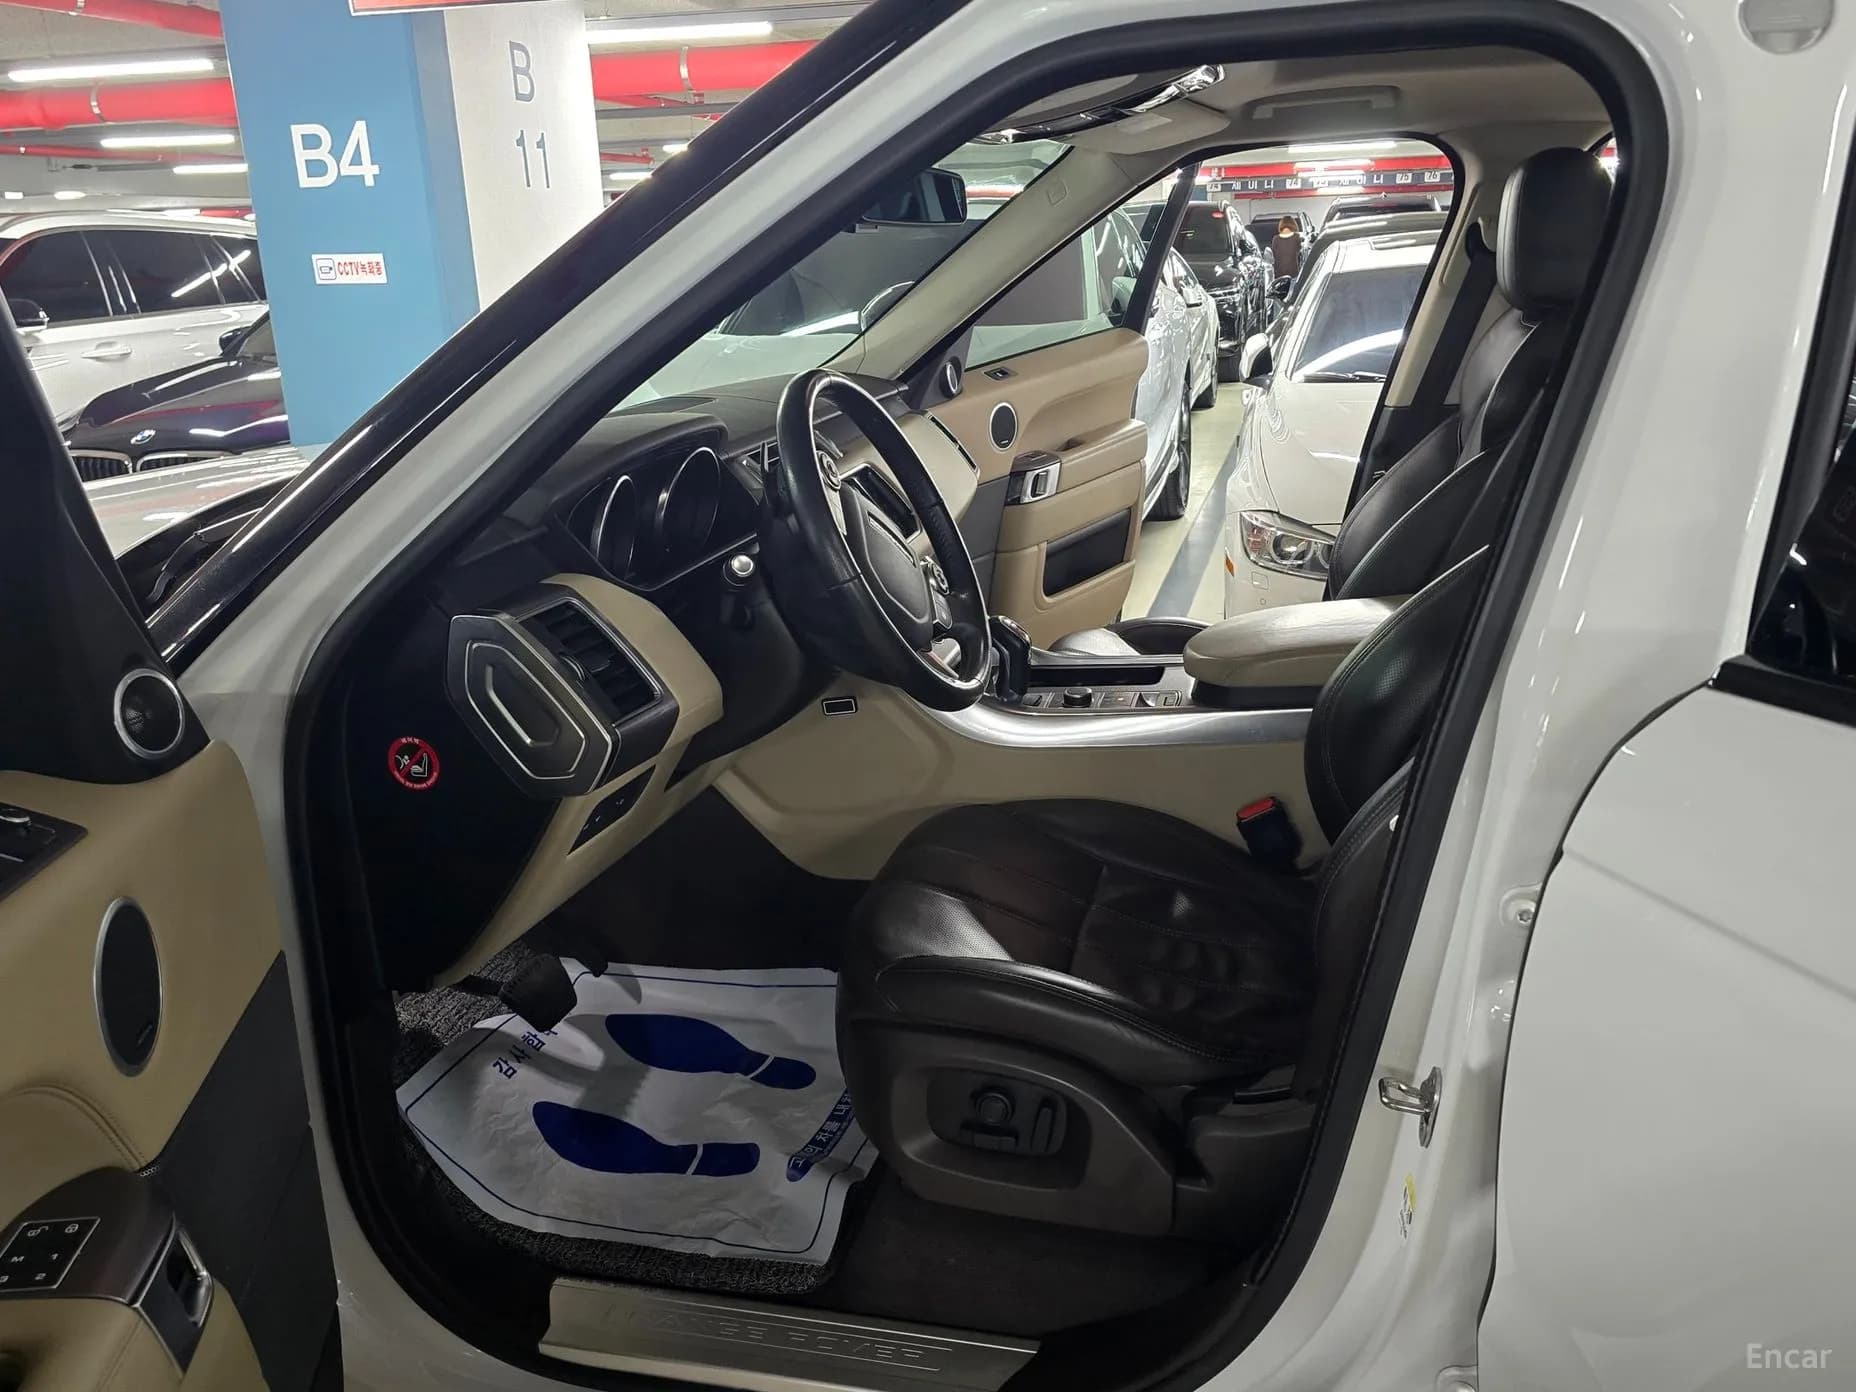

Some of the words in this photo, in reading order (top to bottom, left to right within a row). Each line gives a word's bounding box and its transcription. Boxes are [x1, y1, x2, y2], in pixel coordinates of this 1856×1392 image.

[509, 40, 535, 102] B
[290, 120, 380, 188] B4
[515, 129, 550, 189] 11
[492, 1030, 558, 1079] 감사합
